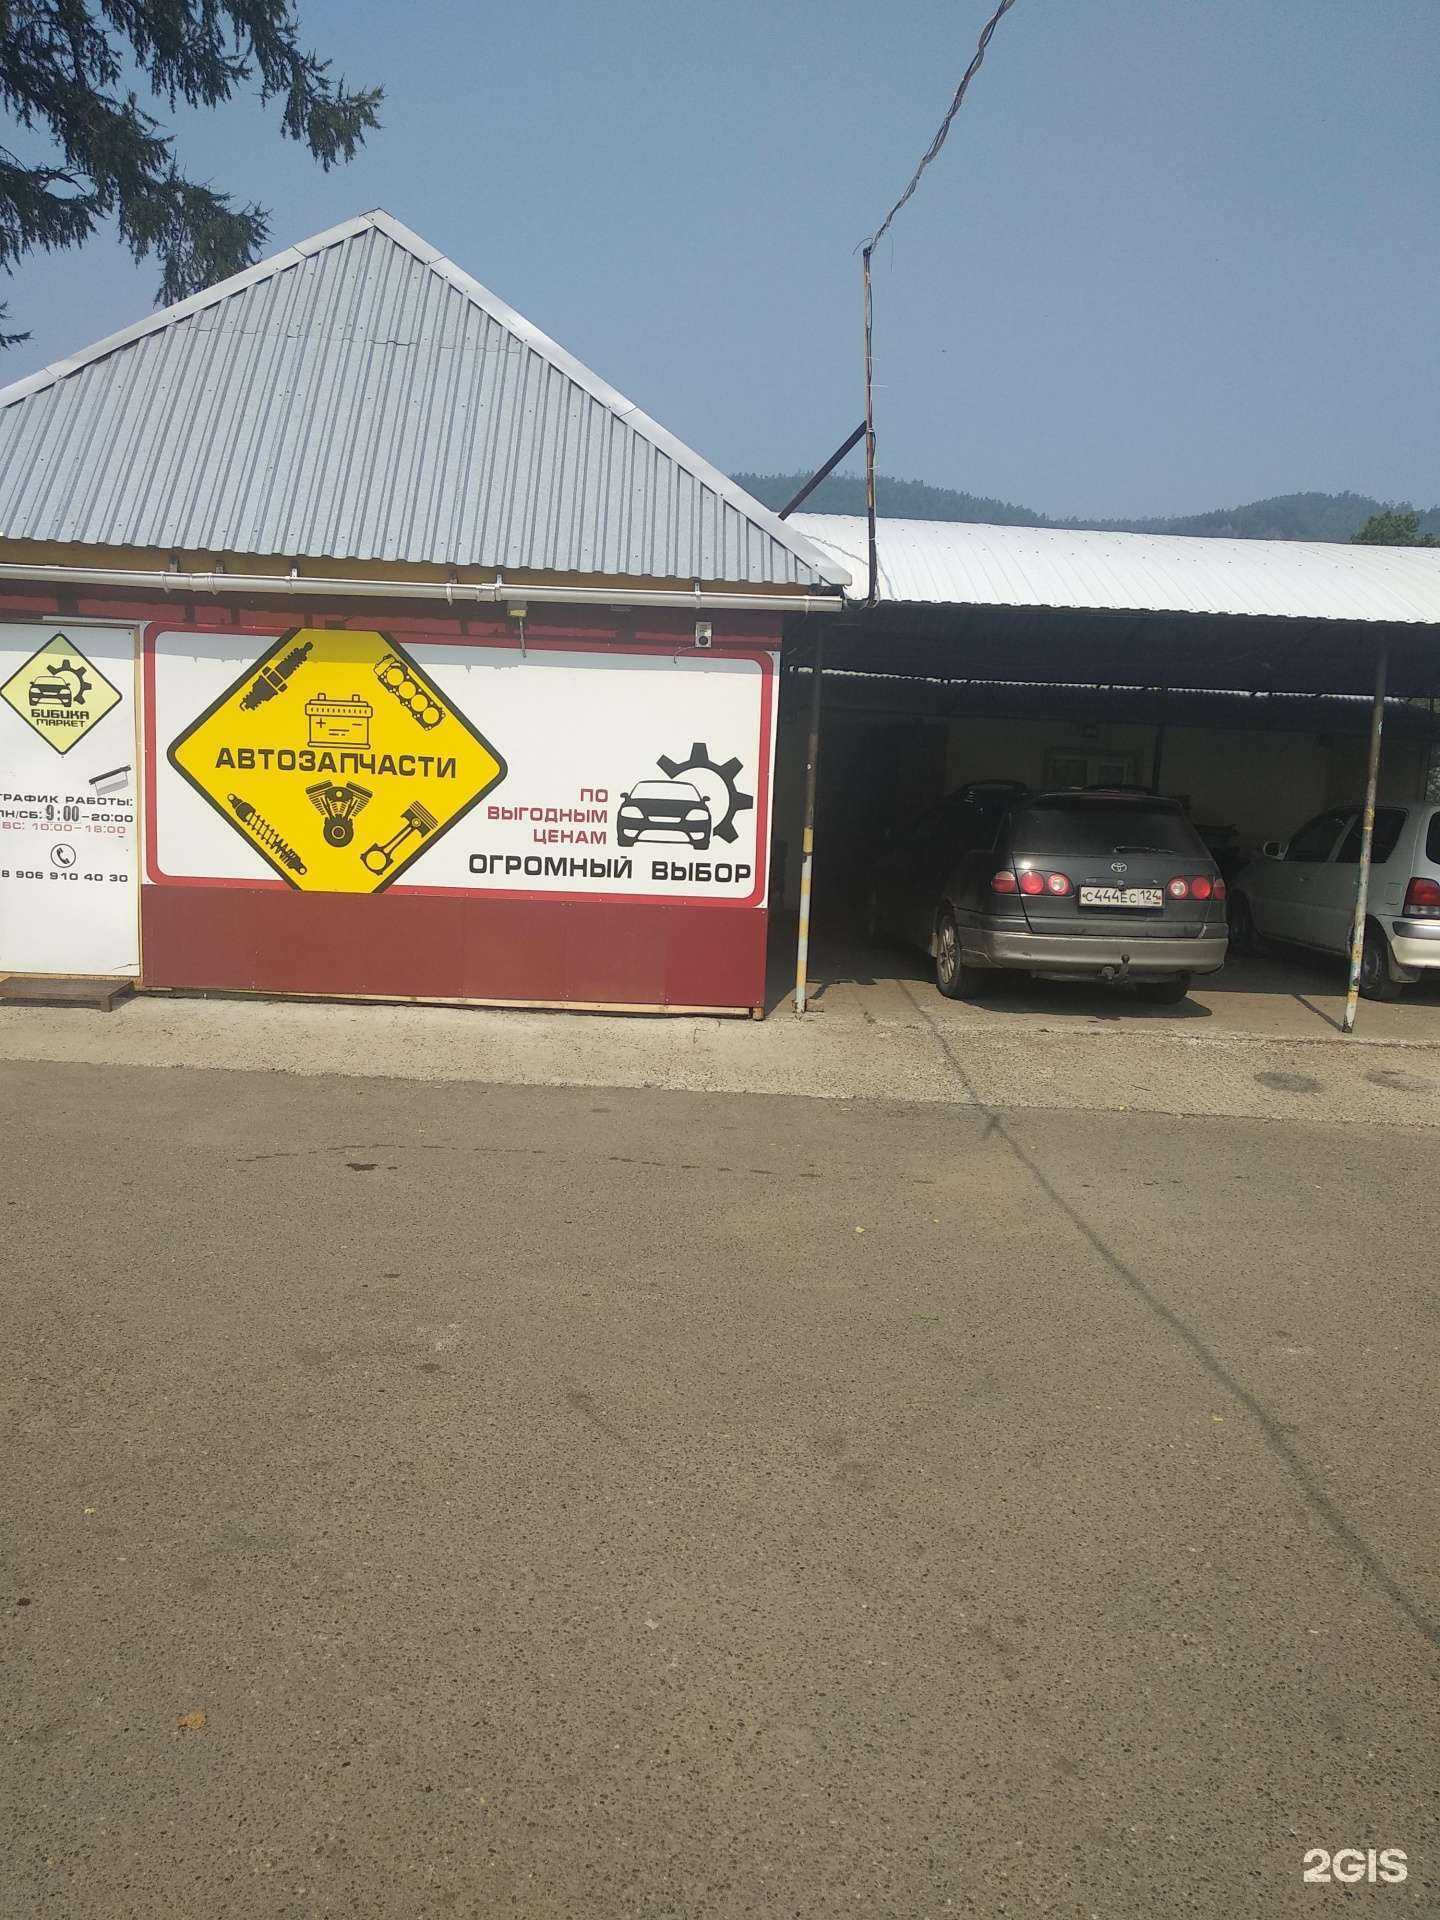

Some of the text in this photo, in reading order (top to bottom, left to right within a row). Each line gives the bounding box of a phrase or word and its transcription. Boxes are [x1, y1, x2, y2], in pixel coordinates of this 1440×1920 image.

[215, 747, 456, 778] АВТОЗАПЧАСТИ
[65, 796, 133, 806] РАБОТЫ:
[580, 788, 608, 802] ПО
[487, 806, 608, 823] ВЫГОДНЫМ
[2, 821, 25, 830] ВС:
[533, 829, 607, 844] ЦЕНАМ
[1, 869, 128, 882] 8 906 910 40 30
[469, 854, 751, 883] ОГРОМНЫЙ ВЫБОР
[1140, 890, 1158, 900] 124
